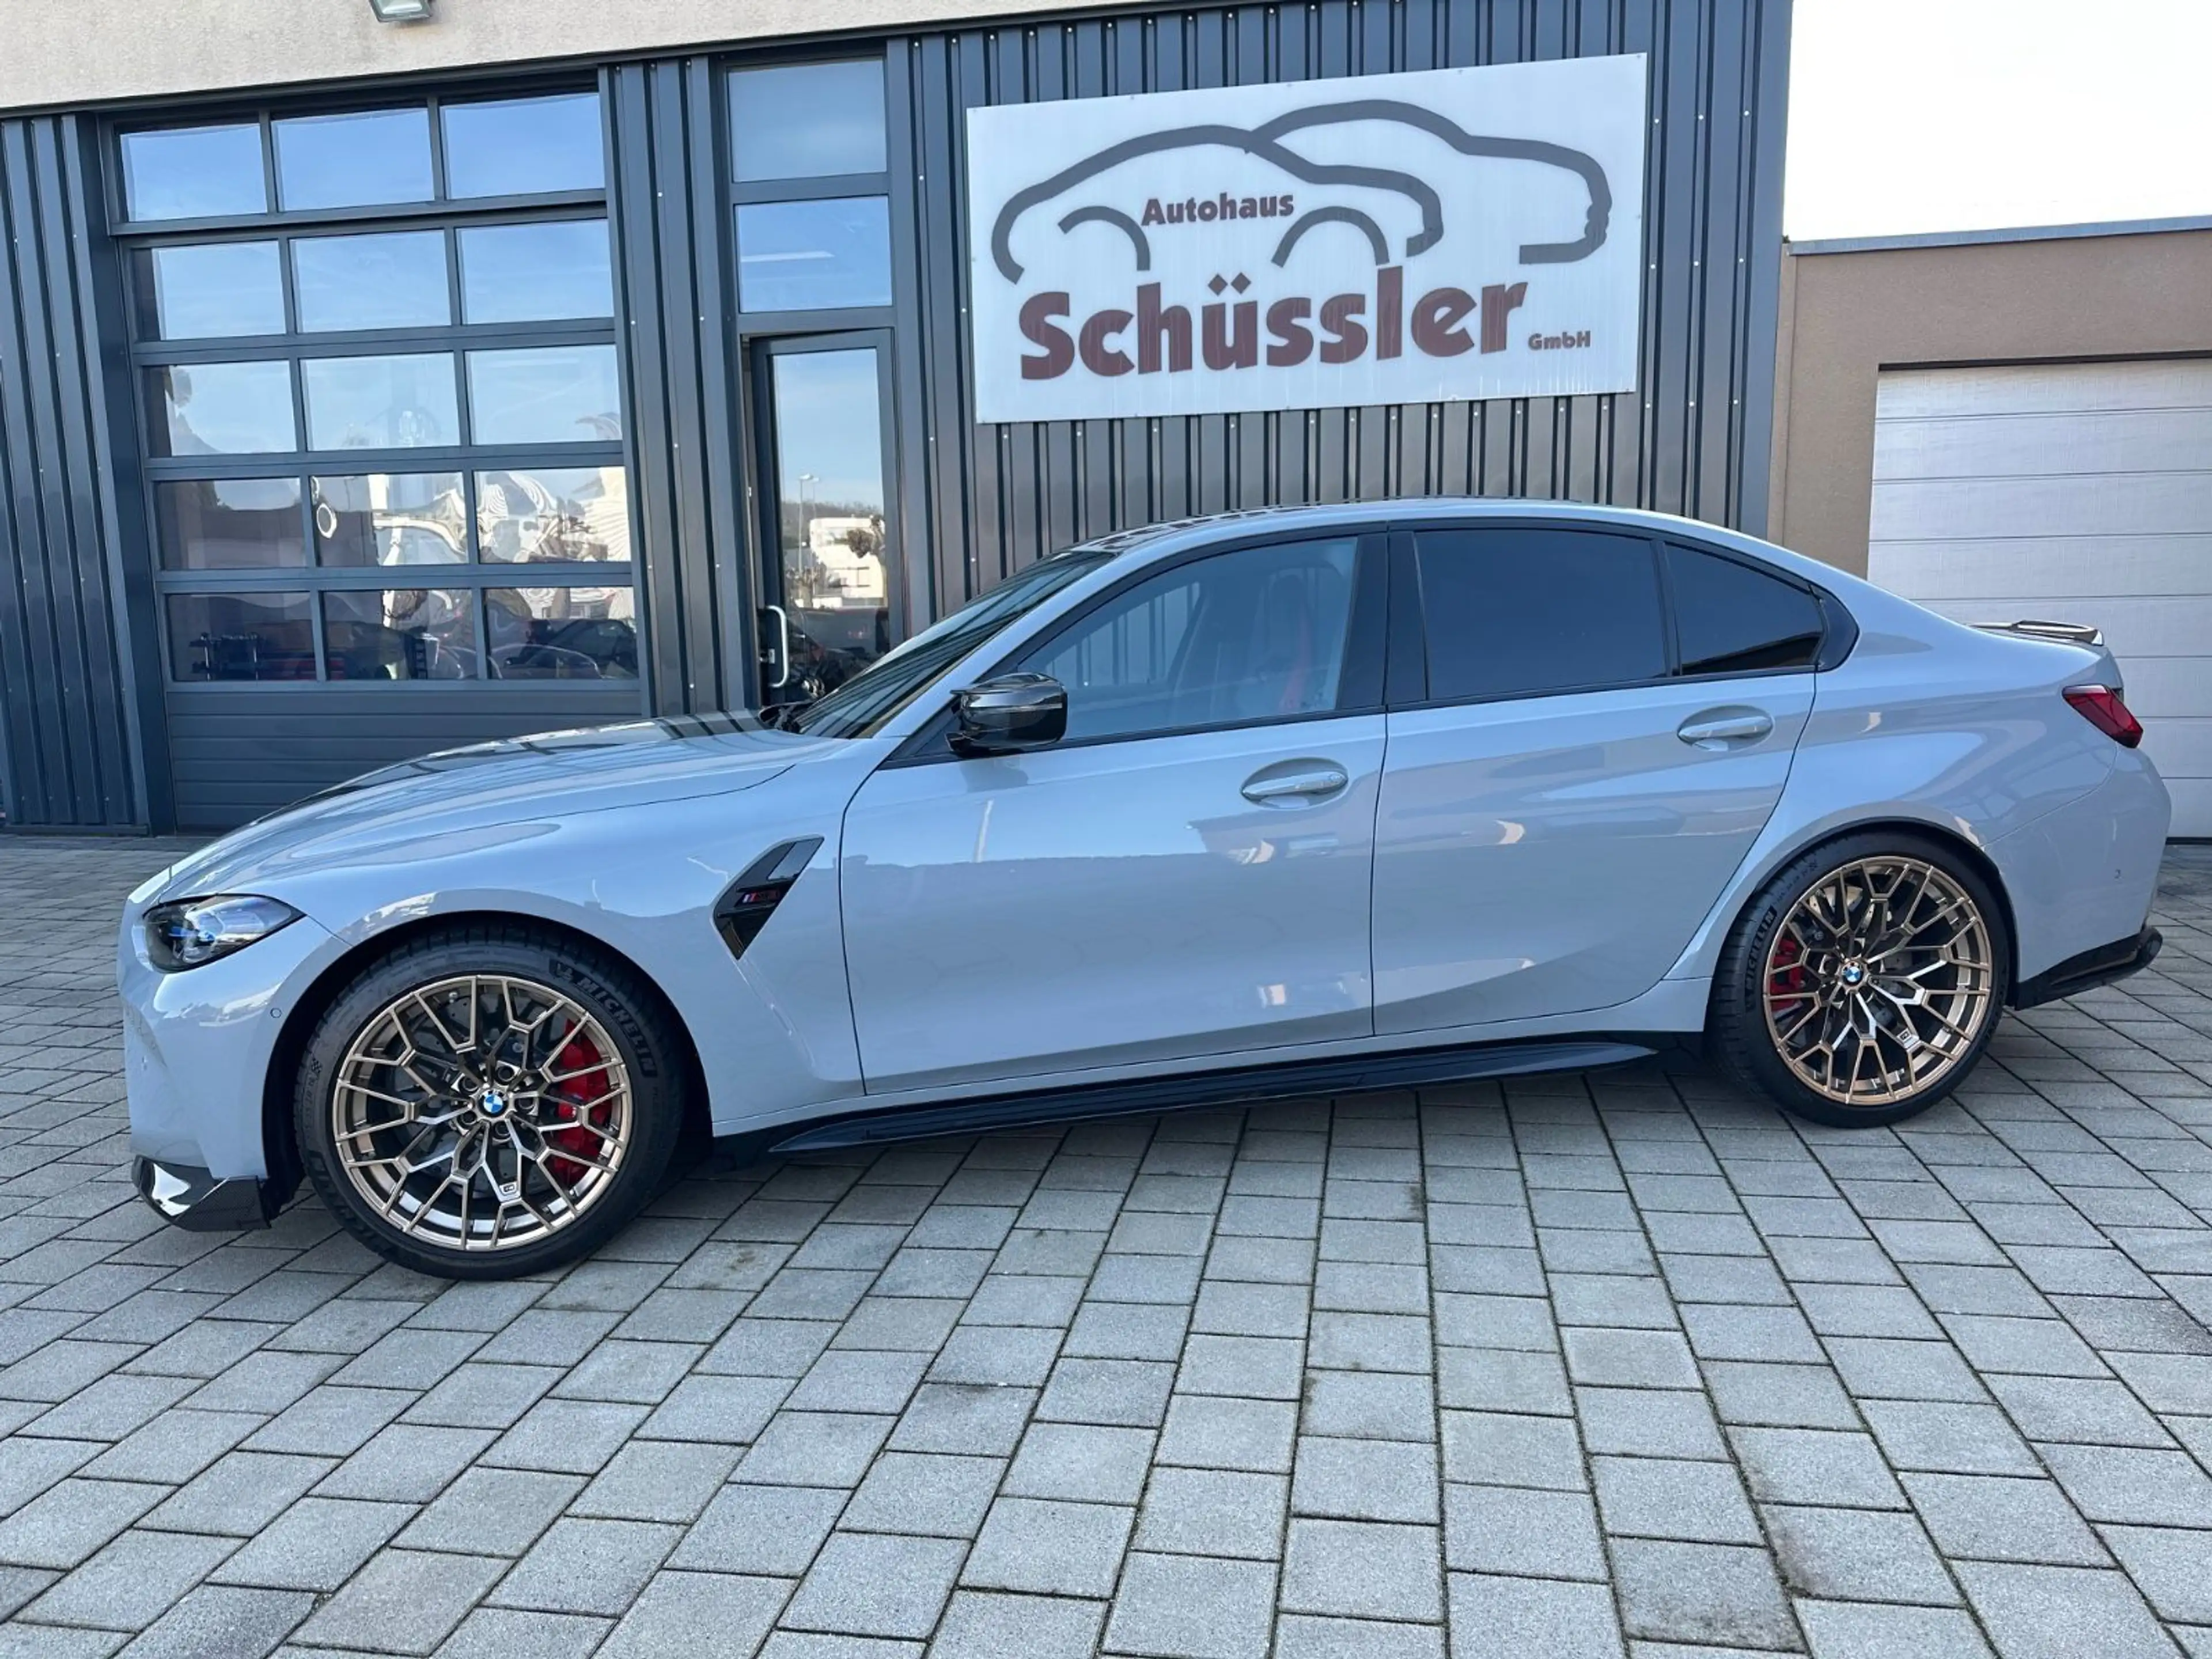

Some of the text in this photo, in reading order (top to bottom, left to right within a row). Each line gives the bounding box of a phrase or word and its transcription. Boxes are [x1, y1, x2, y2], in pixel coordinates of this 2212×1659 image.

[1141, 192, 1294, 226] Autohaus
[1019, 266, 1591, 380] Schüssler GmbH
[577, 976, 657, 1075] MICHELIN
